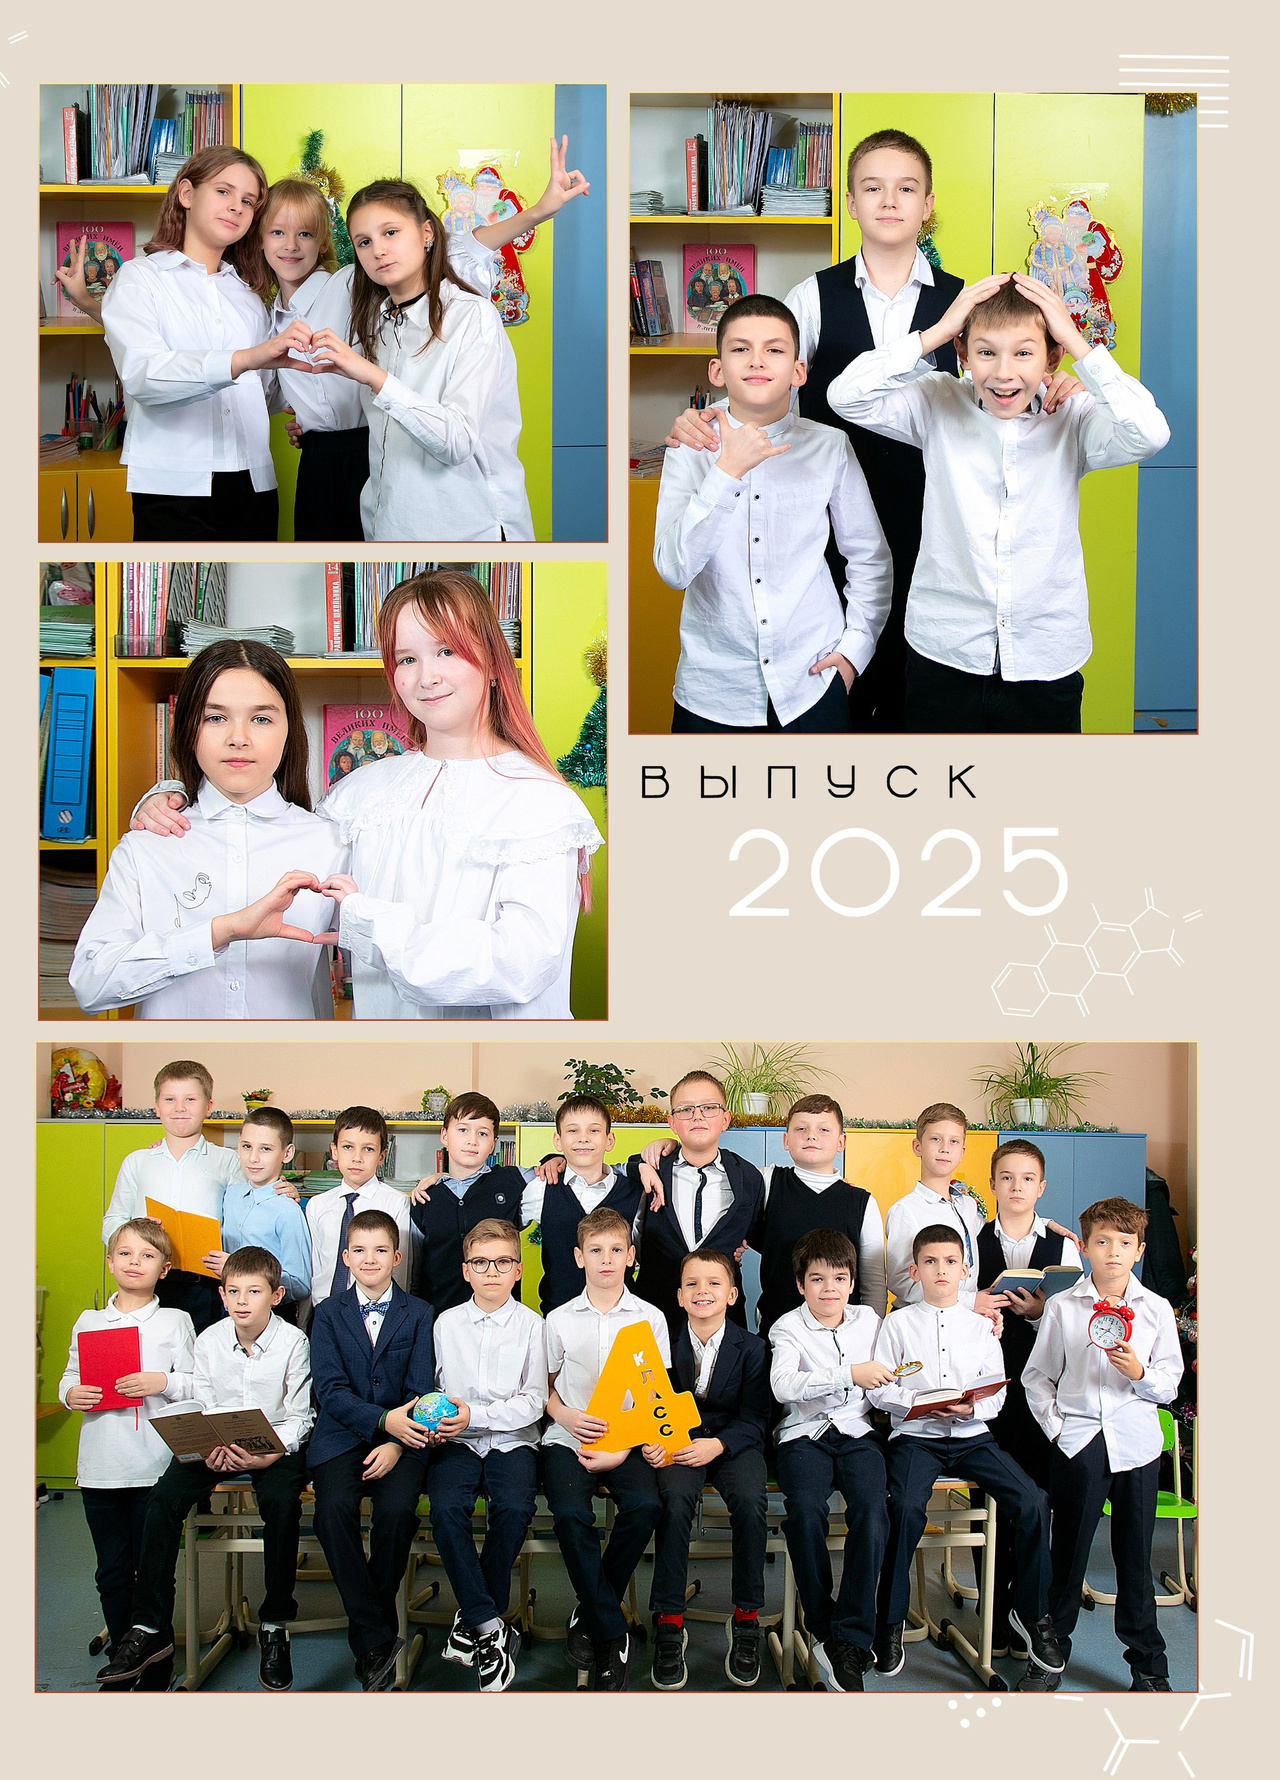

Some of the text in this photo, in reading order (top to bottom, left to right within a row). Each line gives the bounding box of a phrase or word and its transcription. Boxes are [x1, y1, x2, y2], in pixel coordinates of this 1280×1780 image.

[81, 225, 104, 234] 100
[688, 255, 721, 273] ВЕЛИКИХ
[327, 563, 339, 571] 1-4
[332, 581, 340, 618] ШКОЛЬНИКА
[354, 709, 384, 719] 100
[331, 720, 376, 744] ВЕЛИКИХ
